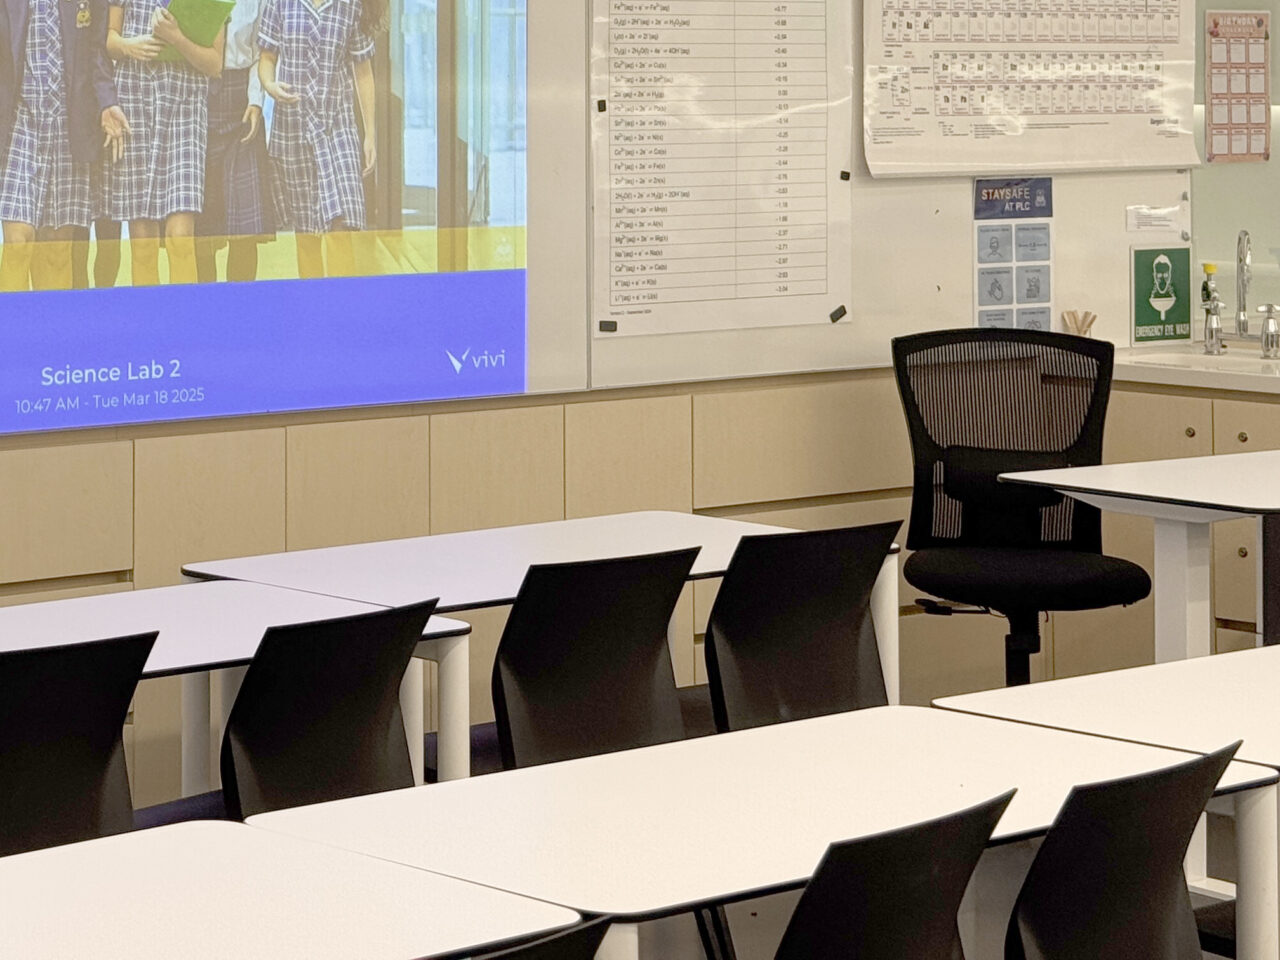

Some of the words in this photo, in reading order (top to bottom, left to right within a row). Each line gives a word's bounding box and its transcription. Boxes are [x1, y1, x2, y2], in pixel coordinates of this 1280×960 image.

[981, 187, 1030, 200] STAYSAFE
[1005, 202, 1013, 211] AT
[1016, 202, 1030, 211] PLC
[472, 349, 505, 368] vivi
[41, 364, 120, 386] Science
[128, 360, 164, 380] Lab
[170, 359, 181, 377] 2
[15, 398, 52, 414] 10:47
[56, 396, 79, 410] AM
[93, 394, 119, 408] Tue
[123, 392, 149, 406] Mar
[154, 390, 168, 404] 18
[172, 387, 205, 403] 2025
